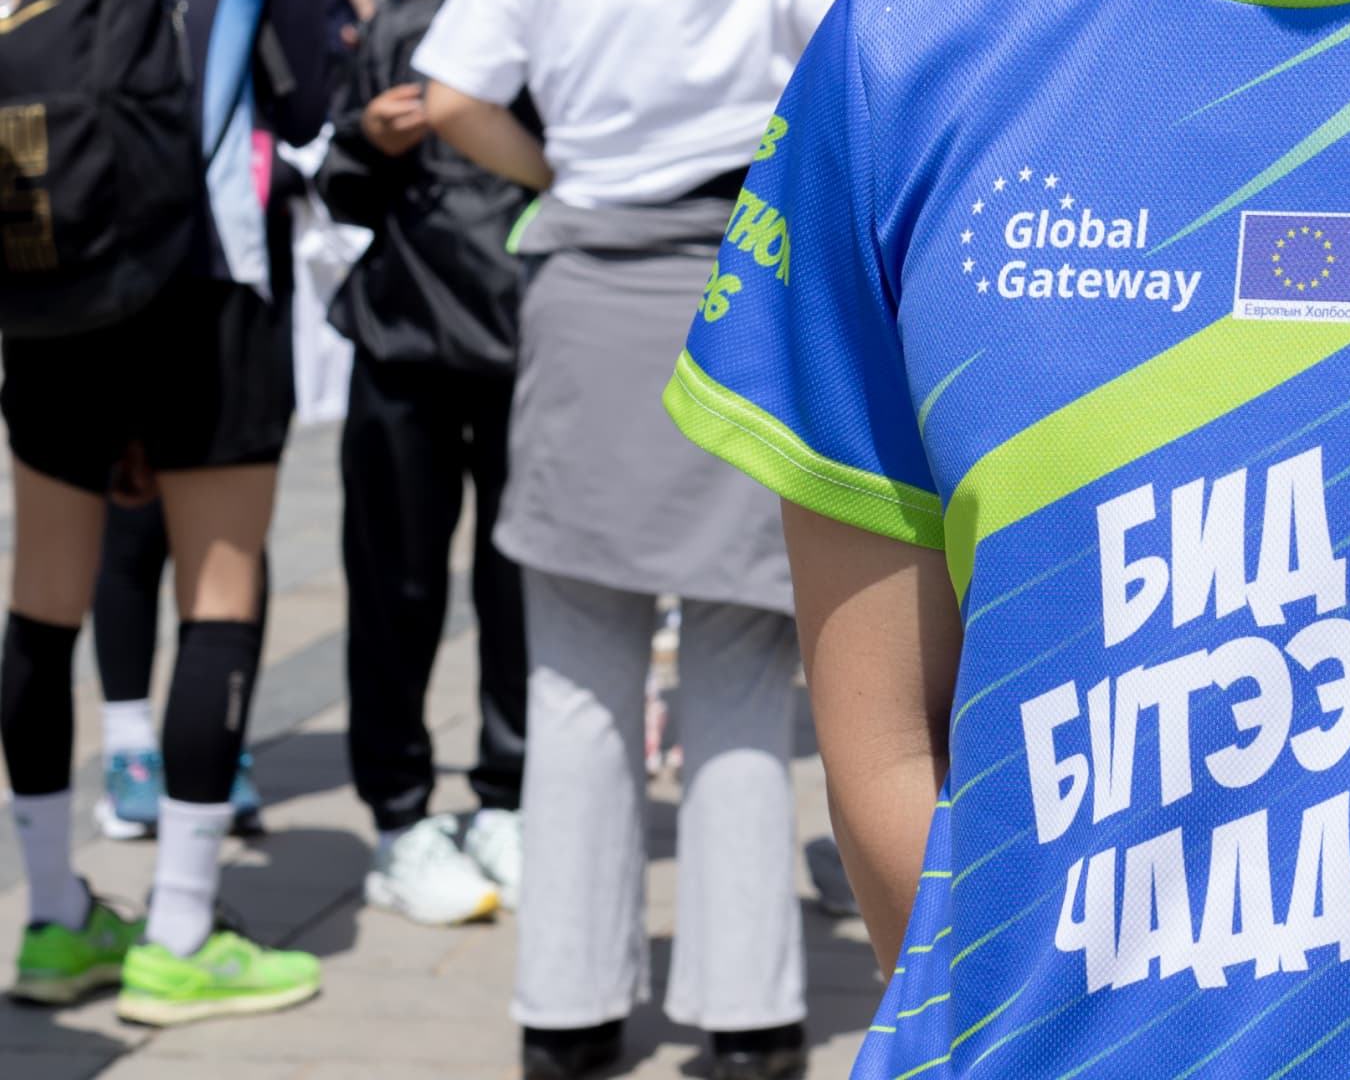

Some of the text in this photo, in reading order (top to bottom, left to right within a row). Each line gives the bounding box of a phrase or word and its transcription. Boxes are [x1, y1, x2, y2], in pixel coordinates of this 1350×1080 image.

[1004, 208, 1149, 249] Global
[997, 260, 1202, 312] Gateway
[1244, 303, 1302, 318] Европын
[1096, 446, 1346, 648] БИД
